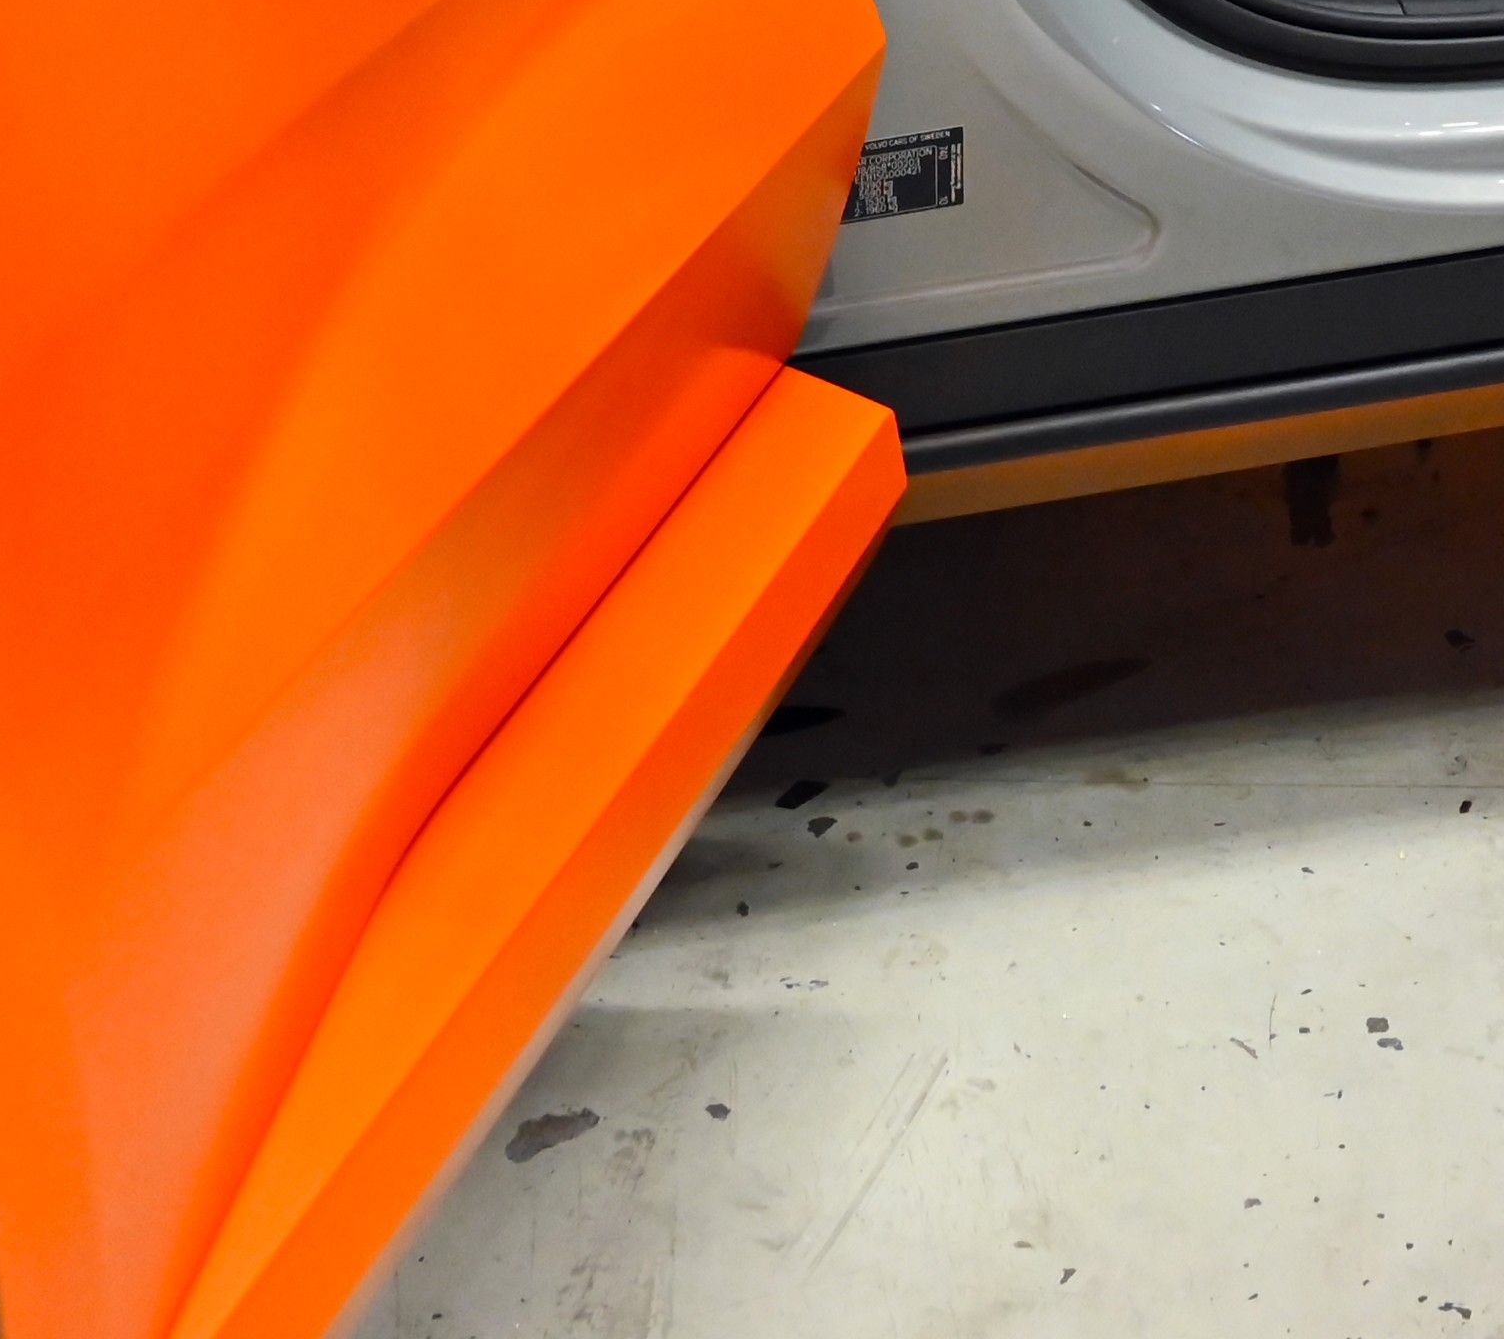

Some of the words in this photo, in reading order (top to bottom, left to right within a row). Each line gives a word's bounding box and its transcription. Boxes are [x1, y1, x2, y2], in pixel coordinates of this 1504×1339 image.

[865, 140, 888, 150] VOLVO
[888, 137, 908, 147] CARS
[908, 135, 919, 143] OF
[920, 130, 951, 142] SWEDEN
[869, 147, 933, 165] CORPORATION
